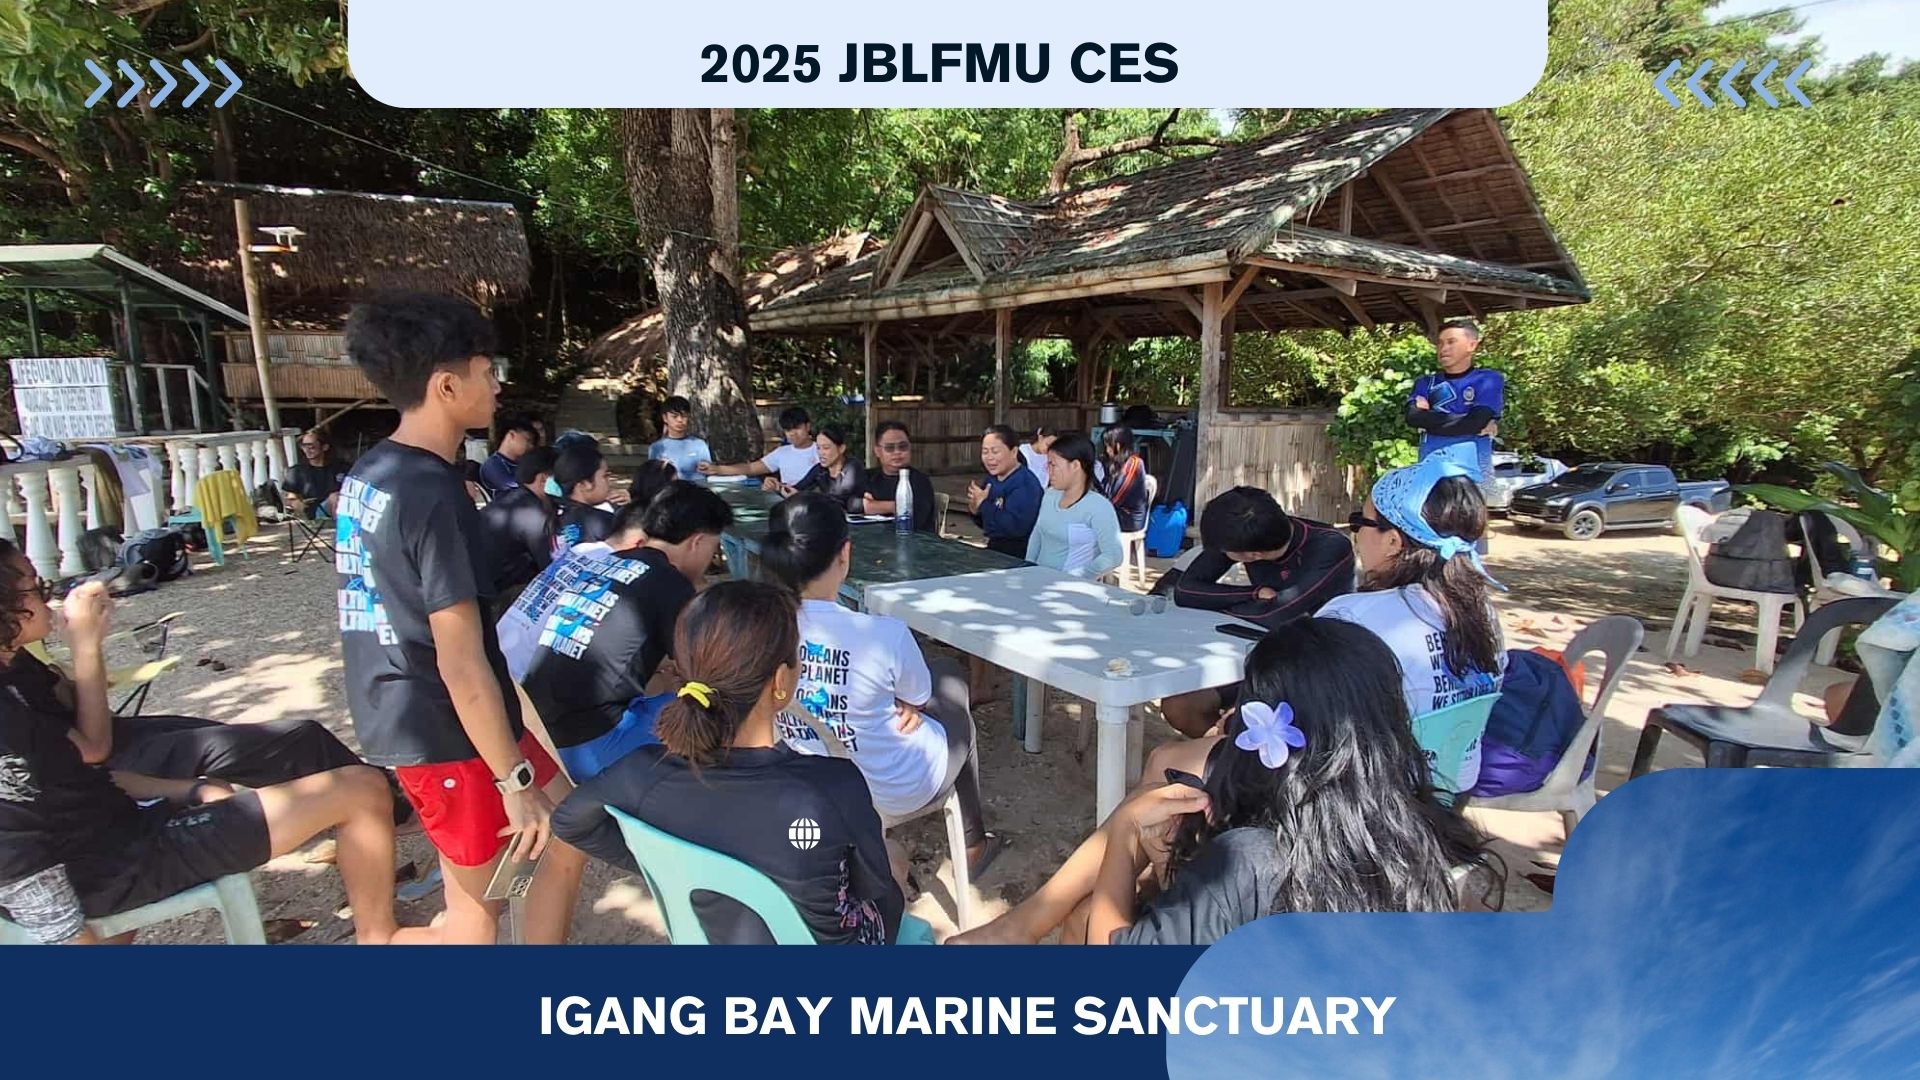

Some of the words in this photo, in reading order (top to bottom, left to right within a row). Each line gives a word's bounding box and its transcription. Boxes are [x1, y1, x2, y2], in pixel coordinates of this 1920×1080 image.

[13, 360, 62, 385] IFEGUARD
[64, 360, 80, 383] ON
[80, 359, 106, 384] DUTY
[800, 663, 850, 686] PLANET
[796, 688, 848, 710] ONS
